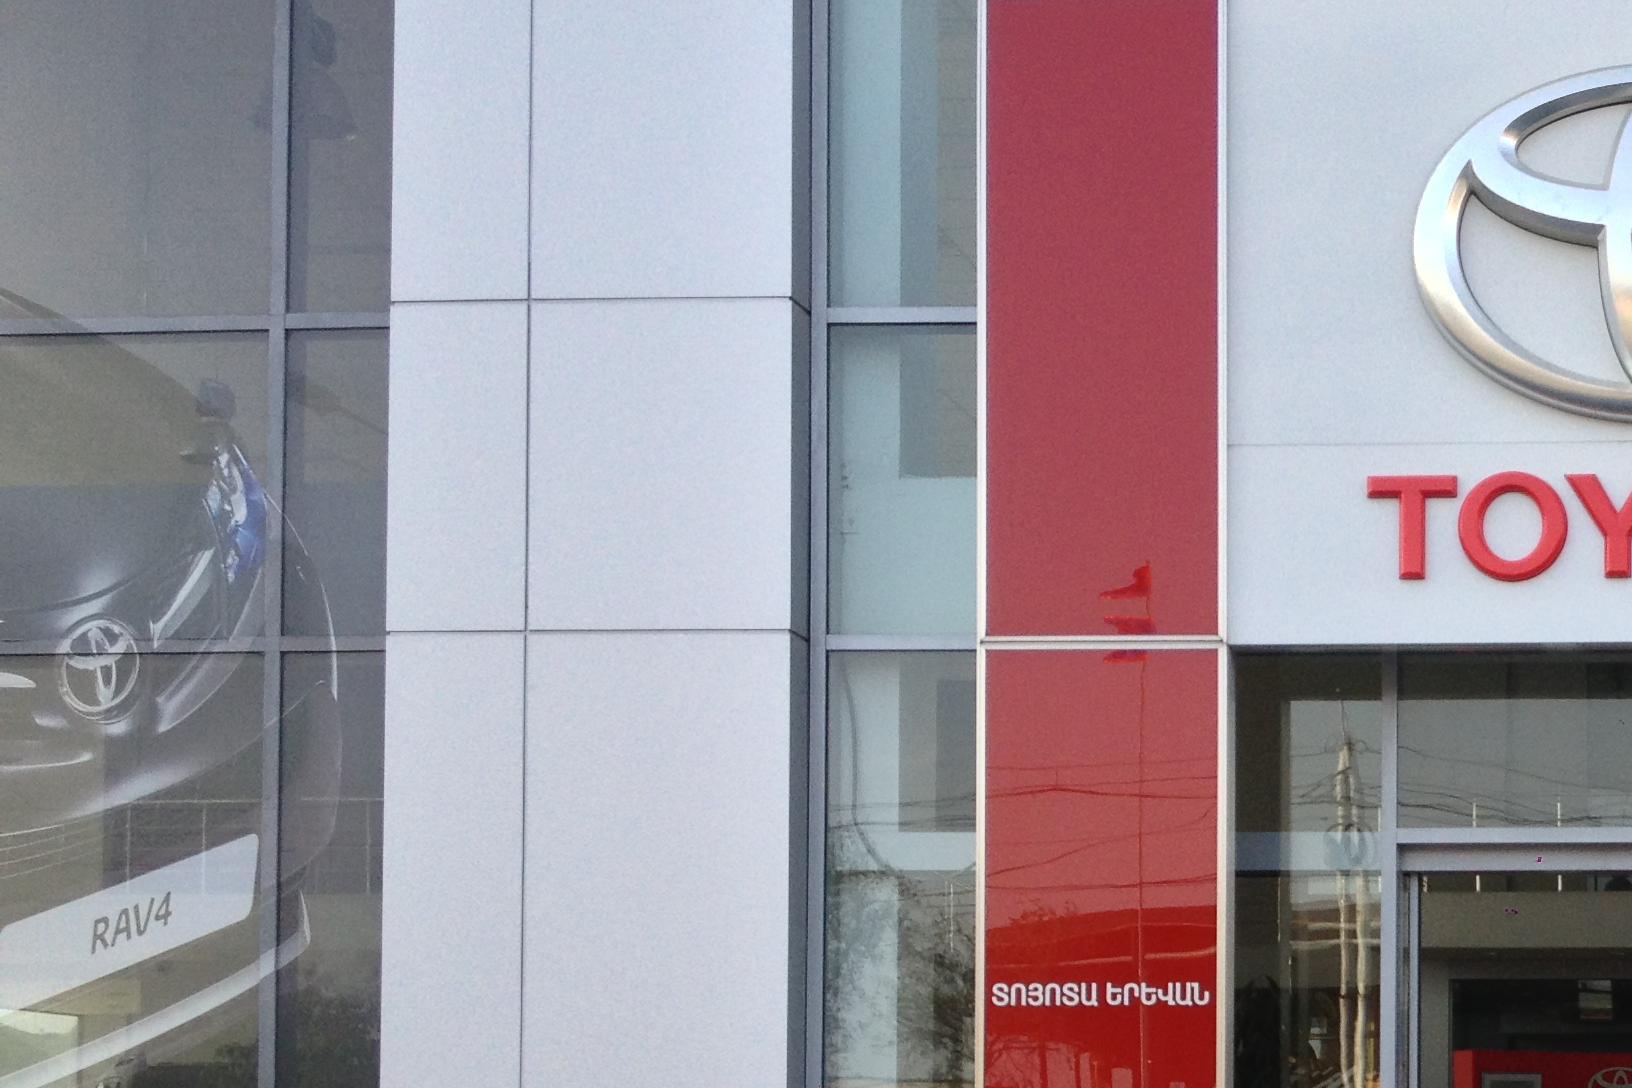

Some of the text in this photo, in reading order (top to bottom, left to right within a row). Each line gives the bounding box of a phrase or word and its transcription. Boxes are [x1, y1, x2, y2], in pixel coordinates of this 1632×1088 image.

[91, 891, 173, 954] RAV4
[991, 982, 1210, 1008] ՏՈՅՈՏԱ ԵՐԵՎԱՆ
